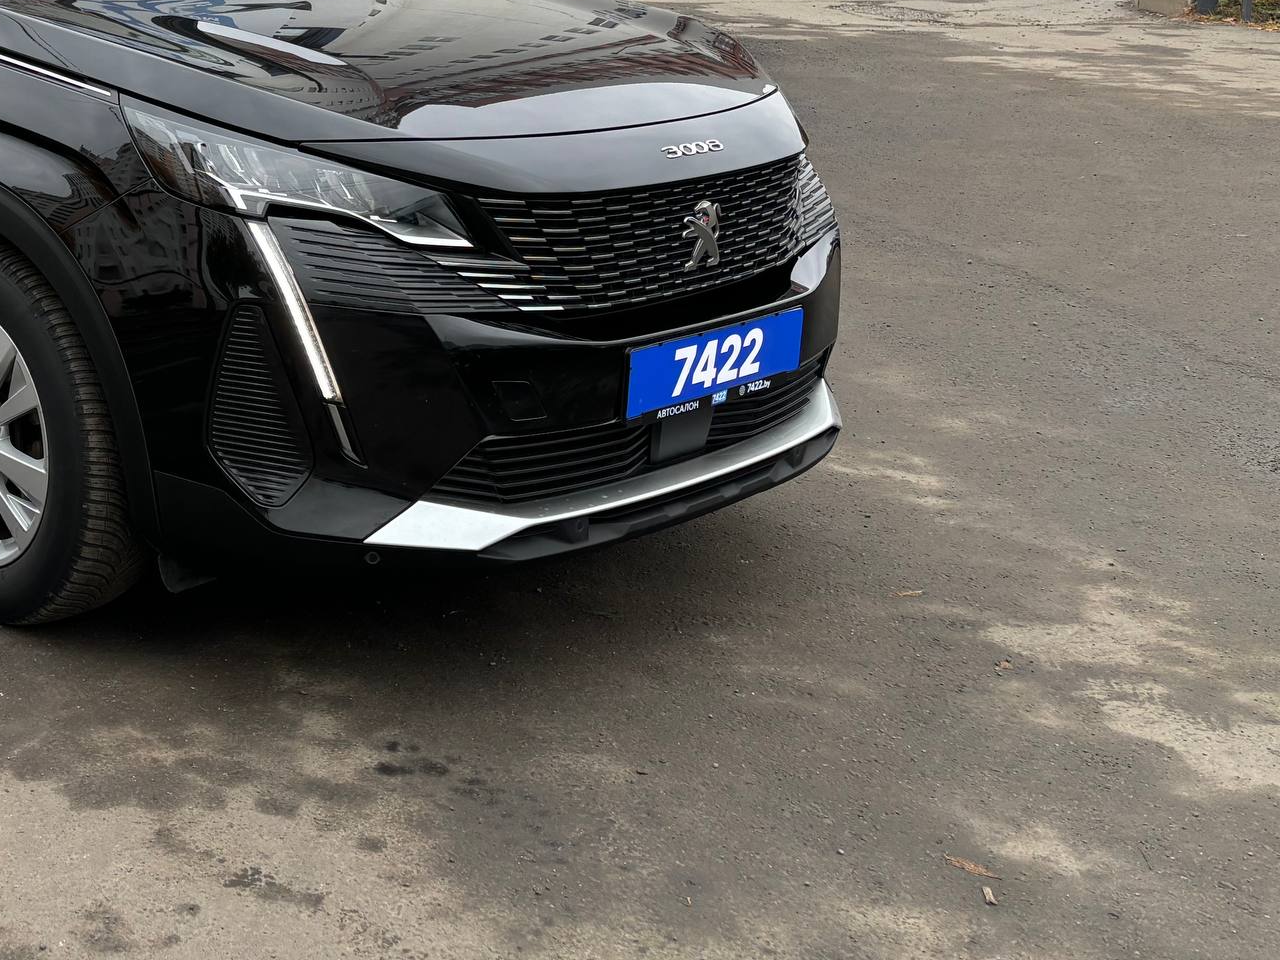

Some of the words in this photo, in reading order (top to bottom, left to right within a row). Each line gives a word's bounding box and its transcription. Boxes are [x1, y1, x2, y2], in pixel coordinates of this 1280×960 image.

[660, 139, 724, 159] 3008
[671, 327, 764, 398] 7422
[657, 401, 699, 419] АВТОСАЛОН
[747, 380, 771, 393] 7422.by
